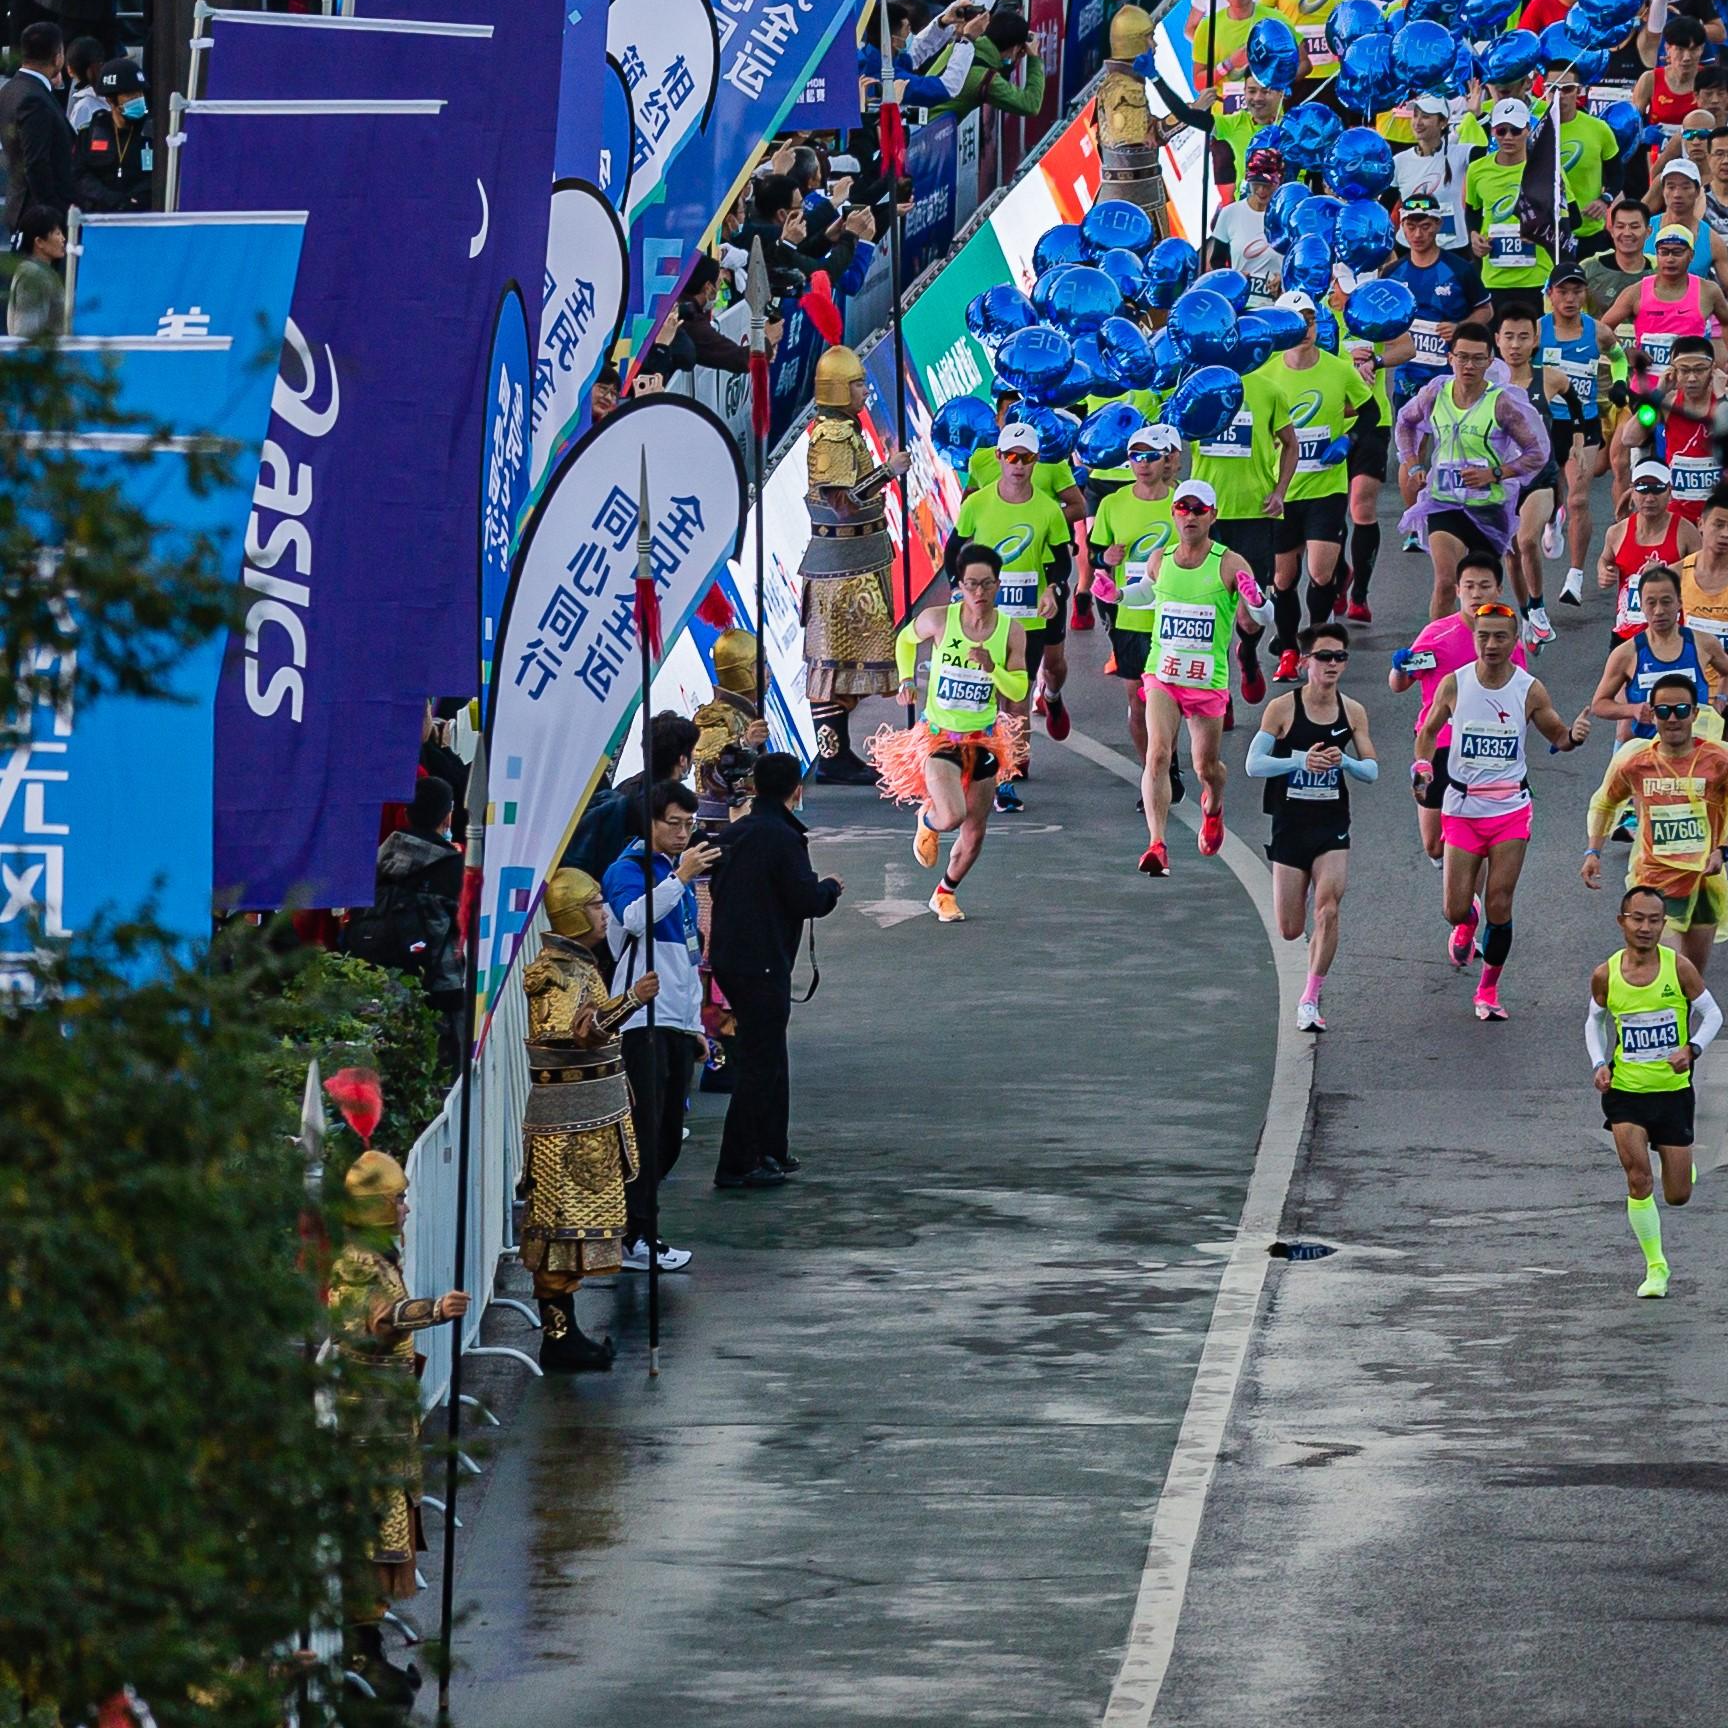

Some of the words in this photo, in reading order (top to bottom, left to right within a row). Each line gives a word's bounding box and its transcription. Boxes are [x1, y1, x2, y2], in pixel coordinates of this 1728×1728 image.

[1500, 236, 1523, 254] 128
[243, 458, 313, 724] asics
[519, 484, 636, 701] 同心同行
[1001, 588, 1024, 604] 110
[1160, 617, 1213, 640] A12660
[939, 678, 992, 702] A15663
[1463, 738, 1518, 761] A13357
[1623, 1026, 1678, 1050] A10443
